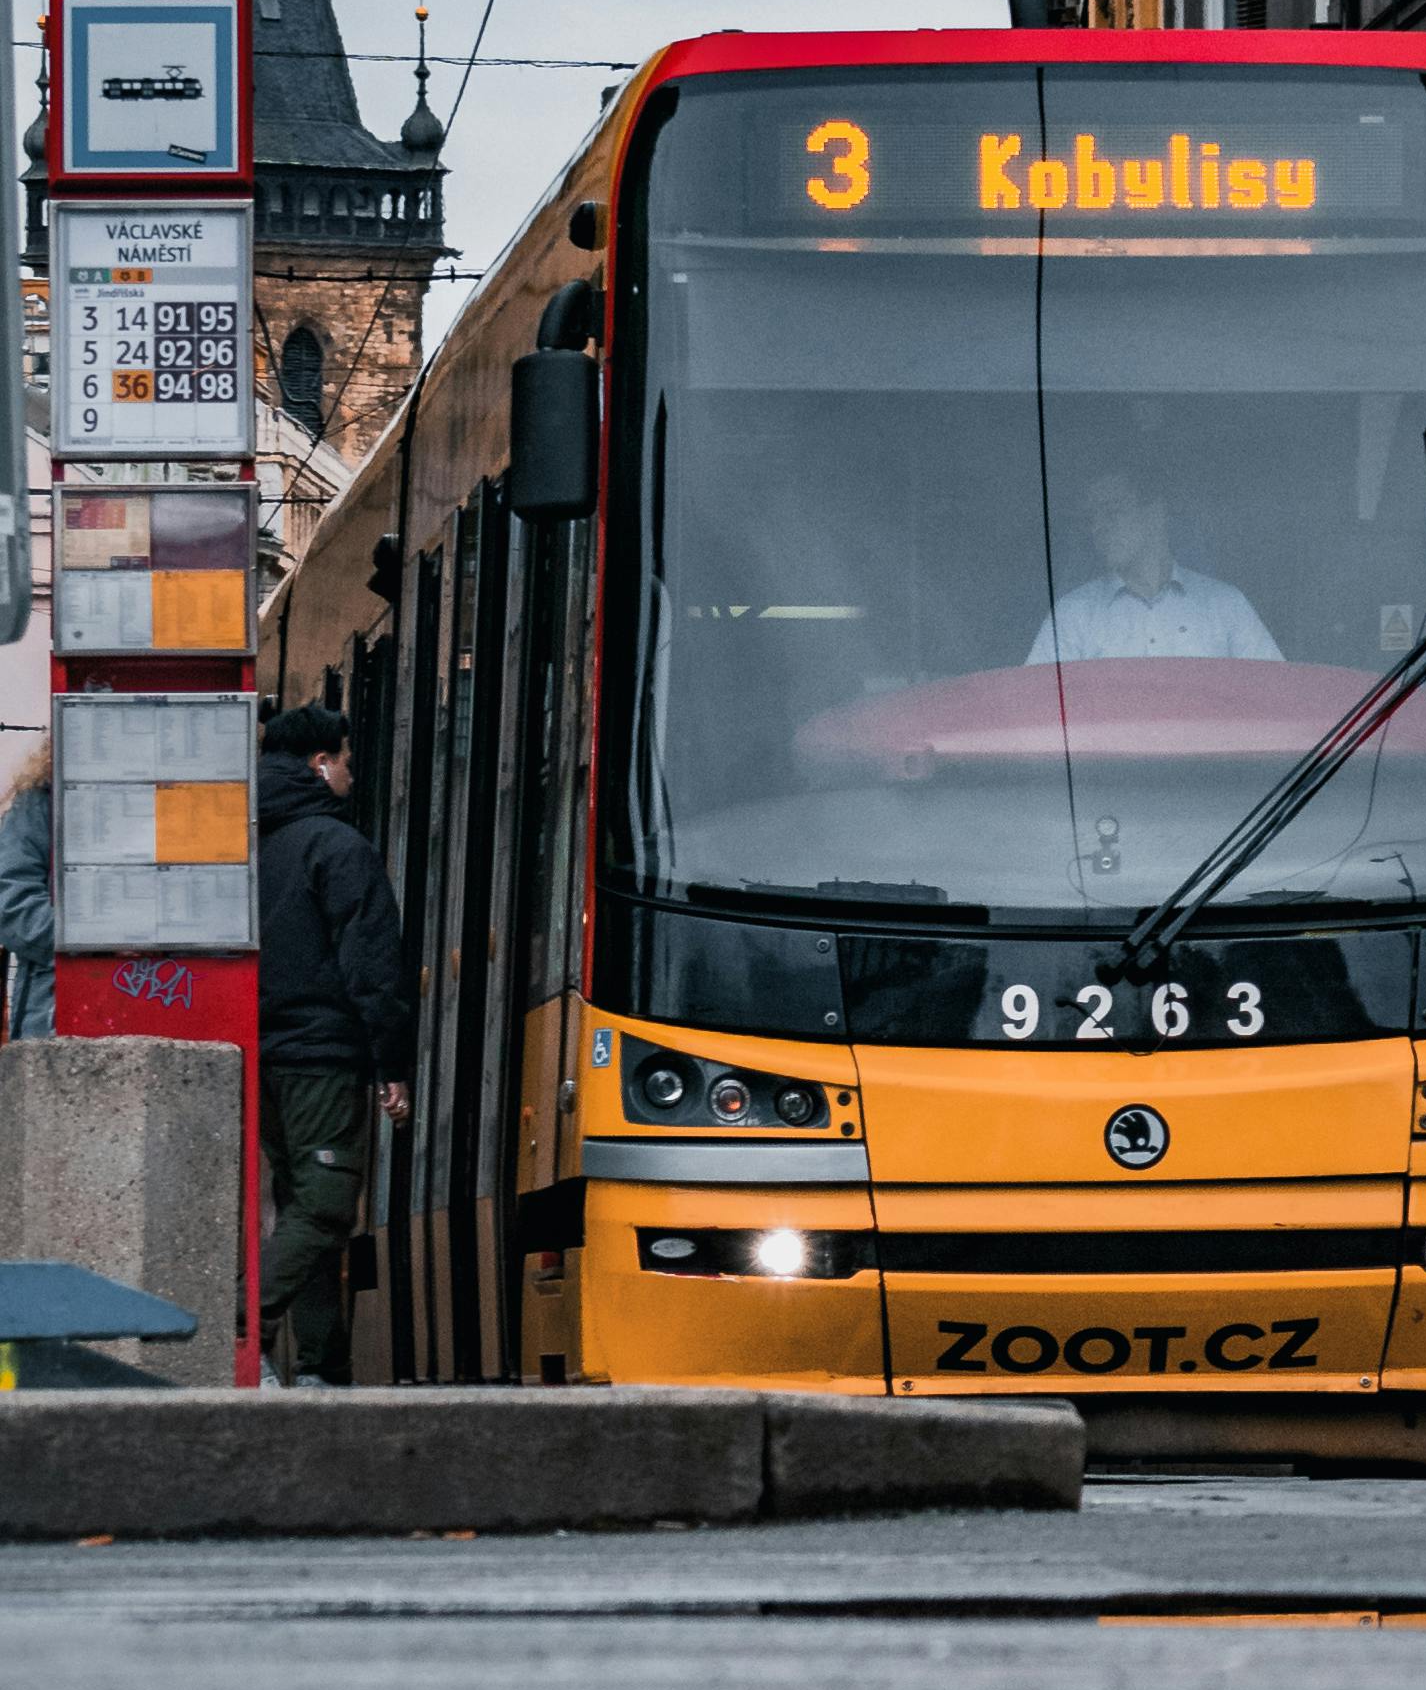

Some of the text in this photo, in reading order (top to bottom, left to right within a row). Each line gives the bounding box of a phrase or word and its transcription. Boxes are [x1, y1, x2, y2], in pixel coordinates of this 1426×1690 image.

[806, 119, 1316, 210] 3 Kobylisy
[105, 220, 204, 240] VÁCLAVSKÉ
[118, 243, 192, 263] NÁMĚSTÍ
[94, 270, 103, 282] A
[82, 305, 234, 332] 3 14 91 95
[83, 339, 234, 366] 5 24 92 96
[83, 373, 234, 400] 6 36 94 98
[83, 408, 98, 432] 9
[1001, 982, 1265, 1040] 9263
[937, 1317, 1320, 1375] ZOOT.CZ
